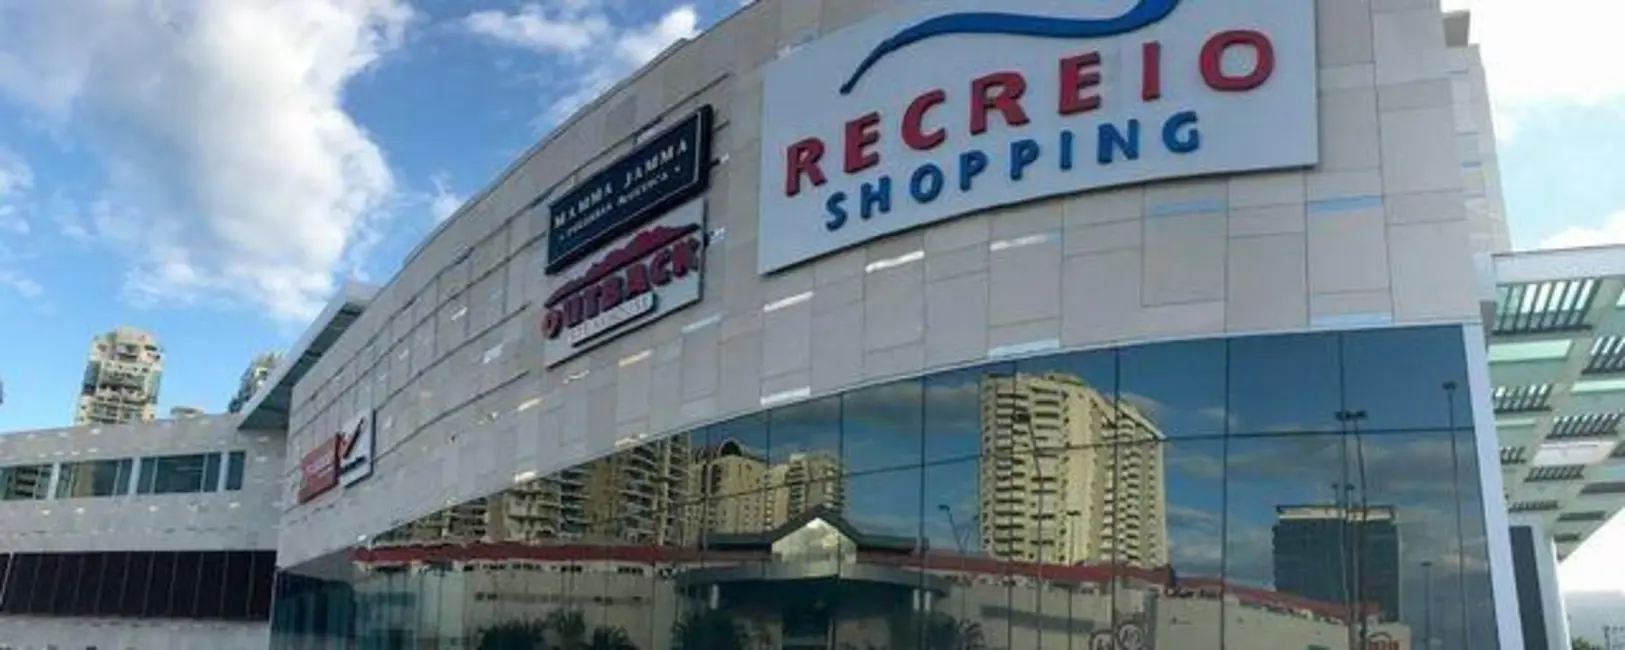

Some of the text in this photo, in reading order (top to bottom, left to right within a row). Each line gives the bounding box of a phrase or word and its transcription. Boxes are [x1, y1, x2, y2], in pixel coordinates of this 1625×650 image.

[785, 30, 1275, 197] RECREIO
[554, 182, 612, 227] MAMMA
[625, 139, 688, 185] JAMMA
[825, 110, 1201, 231] SHOPPING
[542, 237, 702, 339] OUTBACK
